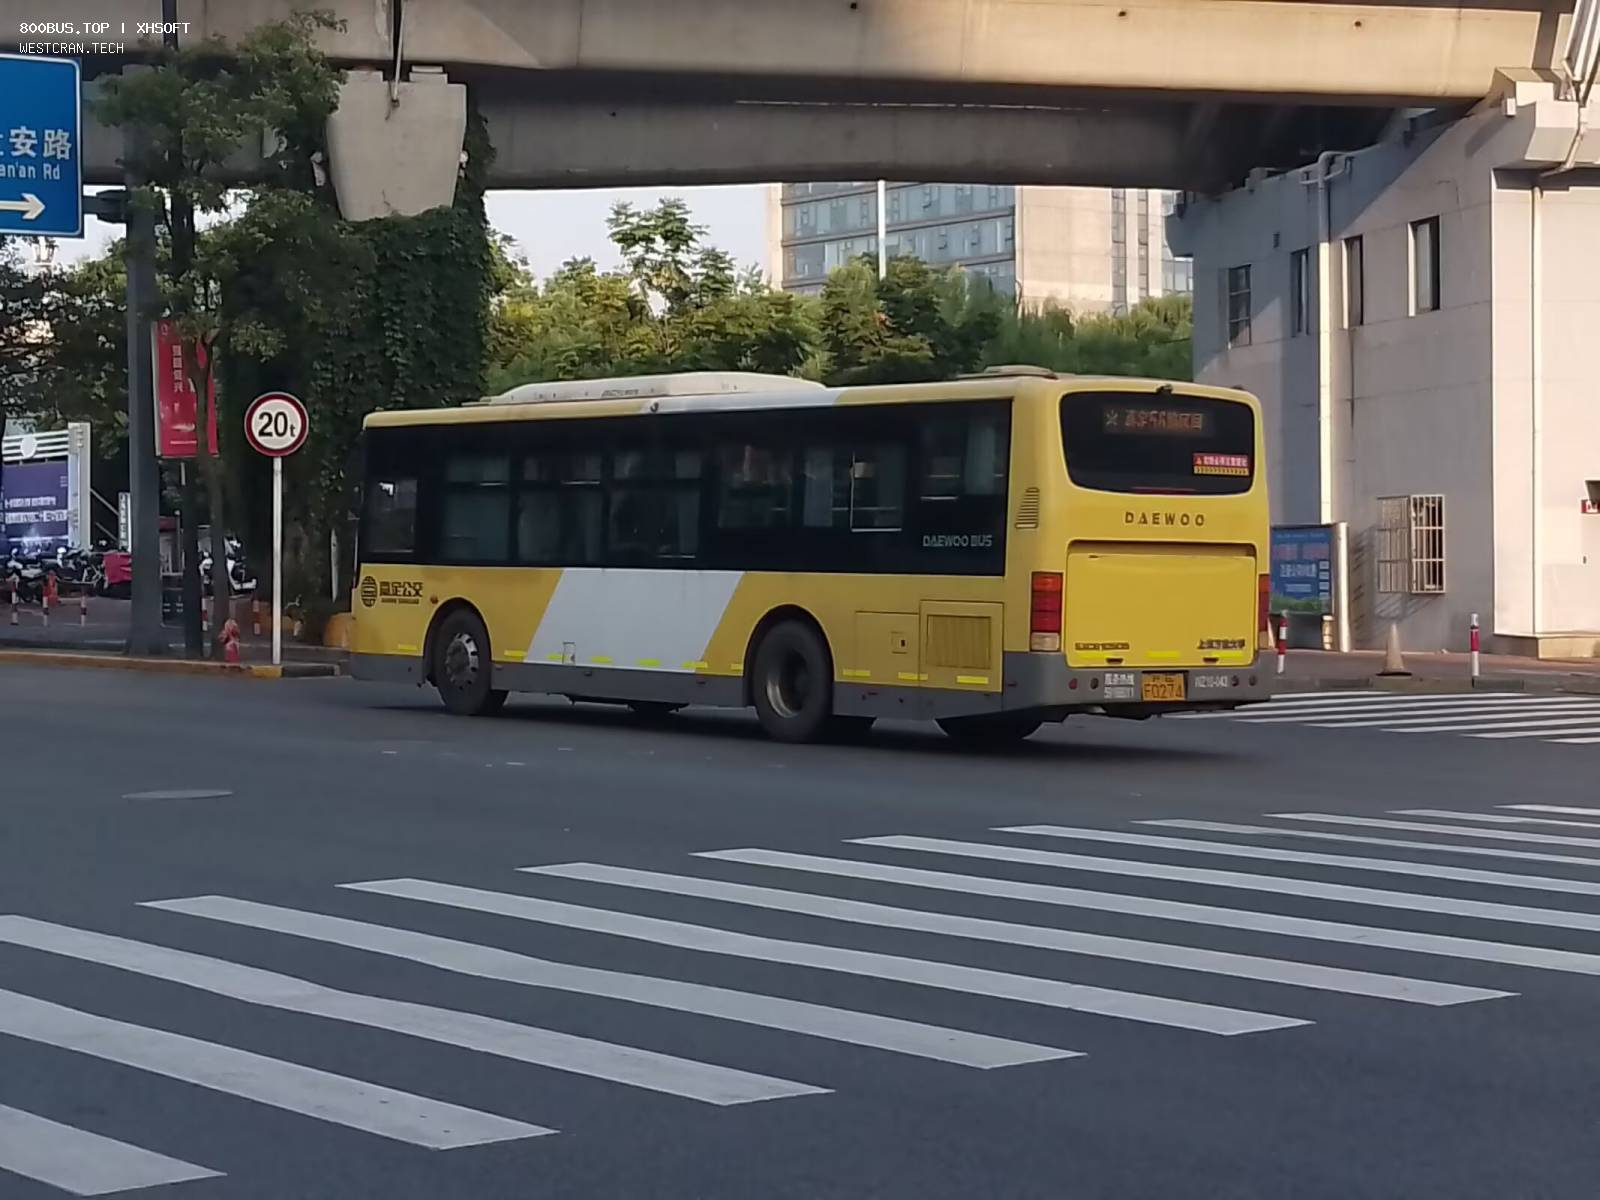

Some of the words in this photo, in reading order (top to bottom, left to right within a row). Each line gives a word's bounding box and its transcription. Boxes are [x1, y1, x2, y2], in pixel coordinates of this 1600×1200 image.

[0, 125, 72, 160] 安路
[43, 163, 60, 180] Rd
[258, 411, 296, 437] 20t
[1125, 511, 1205, 526] DAEWOO
[922, 534, 969, 547] DAEWOO
[970, 534, 993, 547] BUS
[1143, 683, 1184, 699] F0274
